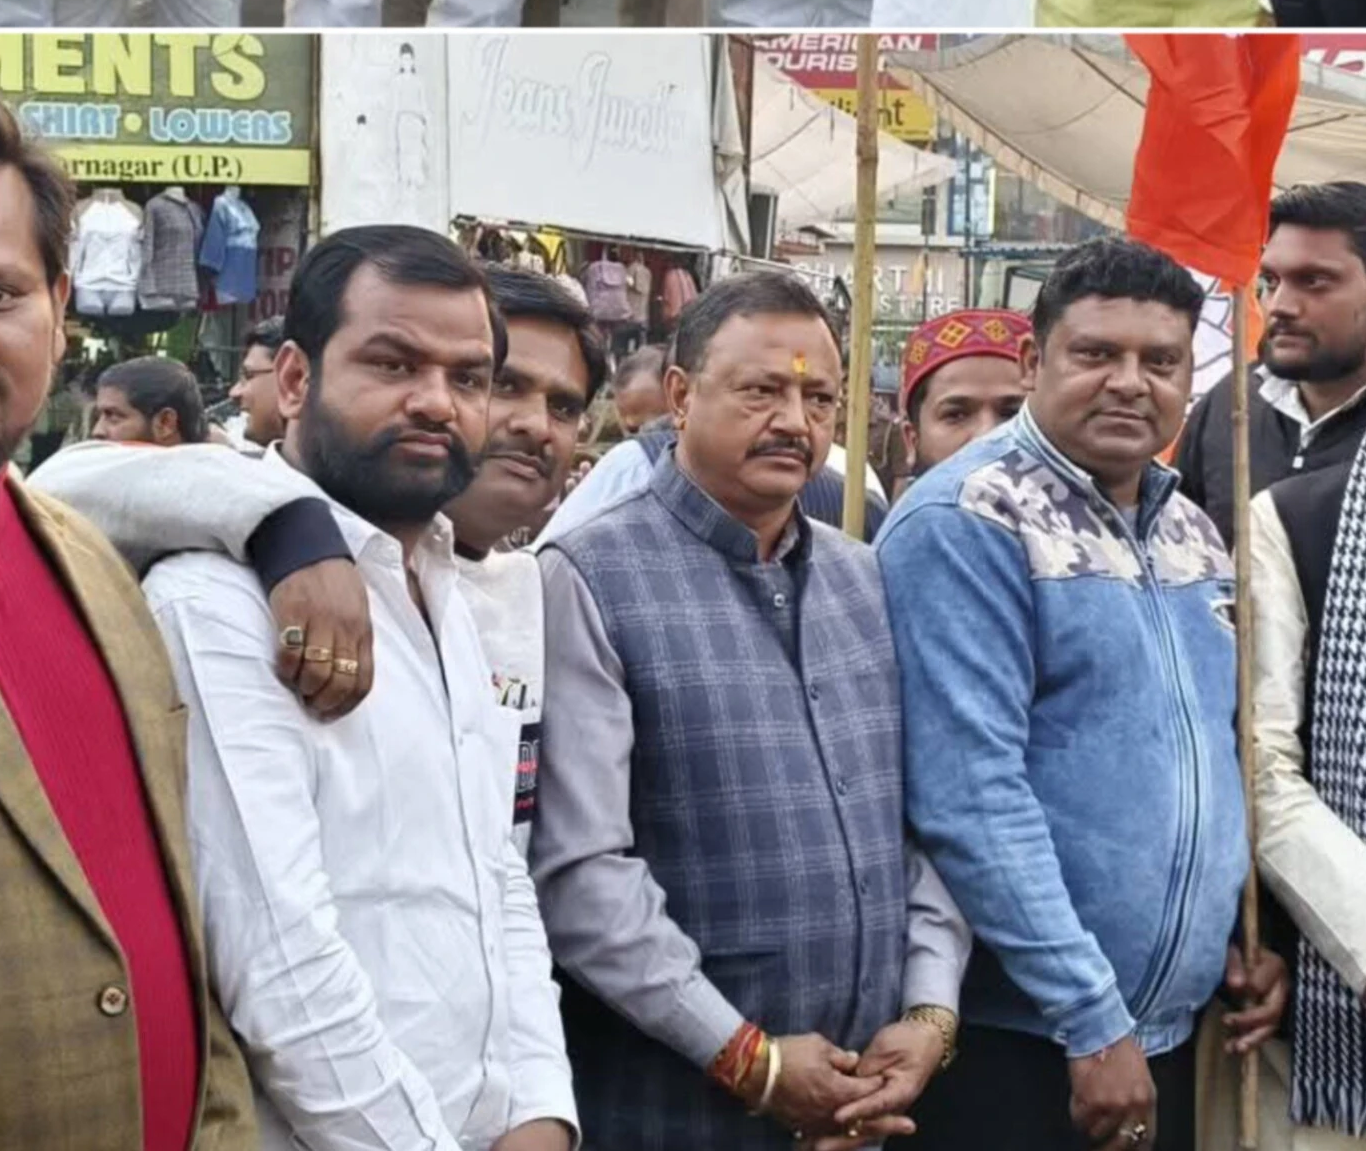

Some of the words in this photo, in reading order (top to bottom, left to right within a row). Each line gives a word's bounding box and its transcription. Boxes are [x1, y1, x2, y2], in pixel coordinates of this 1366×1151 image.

[148, 107, 293, 145] LOWERS
[62, 155, 164, 180] rnagar
[171, 153, 244, 182] (U.P.)
